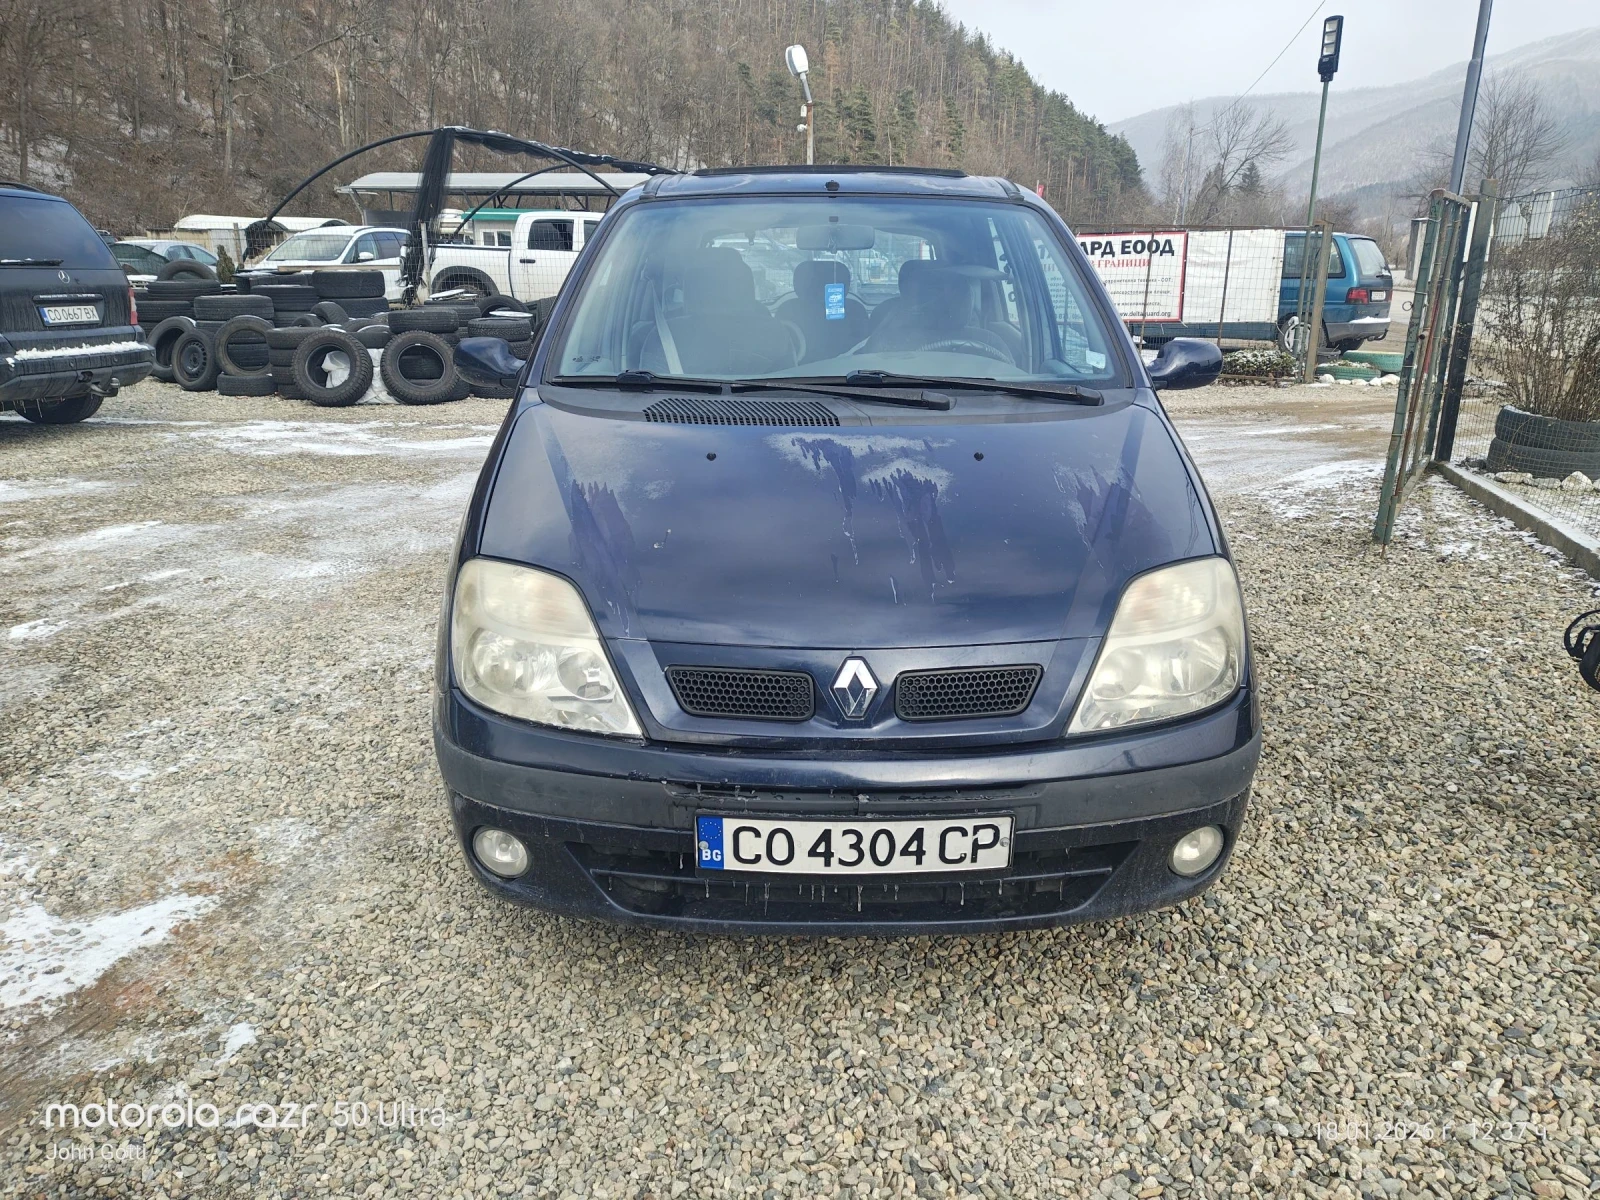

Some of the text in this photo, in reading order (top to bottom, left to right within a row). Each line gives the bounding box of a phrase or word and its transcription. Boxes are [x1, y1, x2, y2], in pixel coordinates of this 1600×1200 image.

[1121, 239, 1175, 257] ЕООД
[1098, 258, 1150, 268] ГРАНИЦИ
[61, 308, 82, 321] 0667
[83, 307, 97, 319] BX
[702, 823, 1000, 867] BG CO 4304 CP
